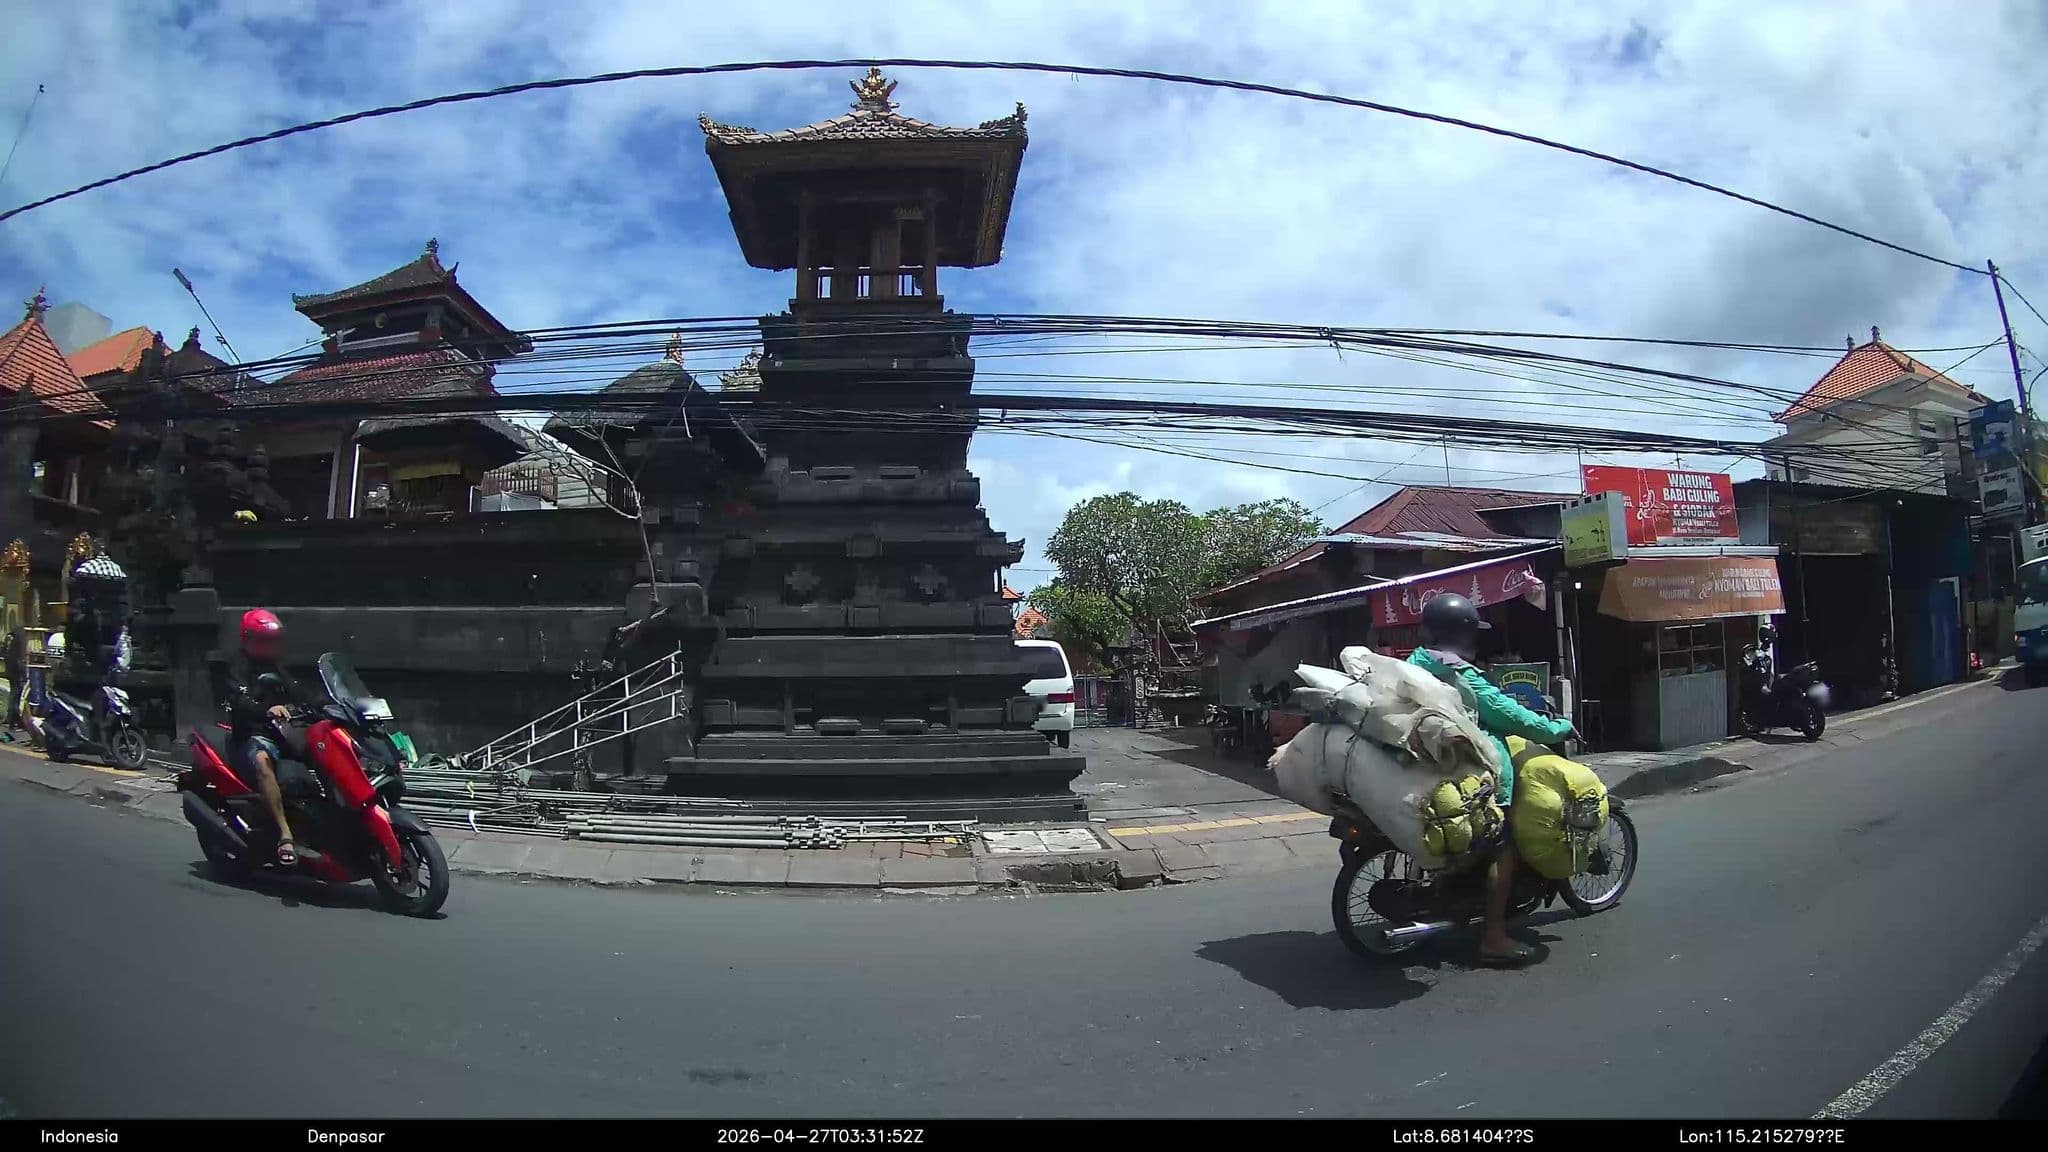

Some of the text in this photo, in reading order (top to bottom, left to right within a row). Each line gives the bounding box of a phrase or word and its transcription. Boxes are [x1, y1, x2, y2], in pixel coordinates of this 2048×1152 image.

[1666, 473, 1713, 489] WARUNG
[1663, 488, 1720, 503] BABI GULING
[1673, 503, 1716, 518] & SIOBAK
